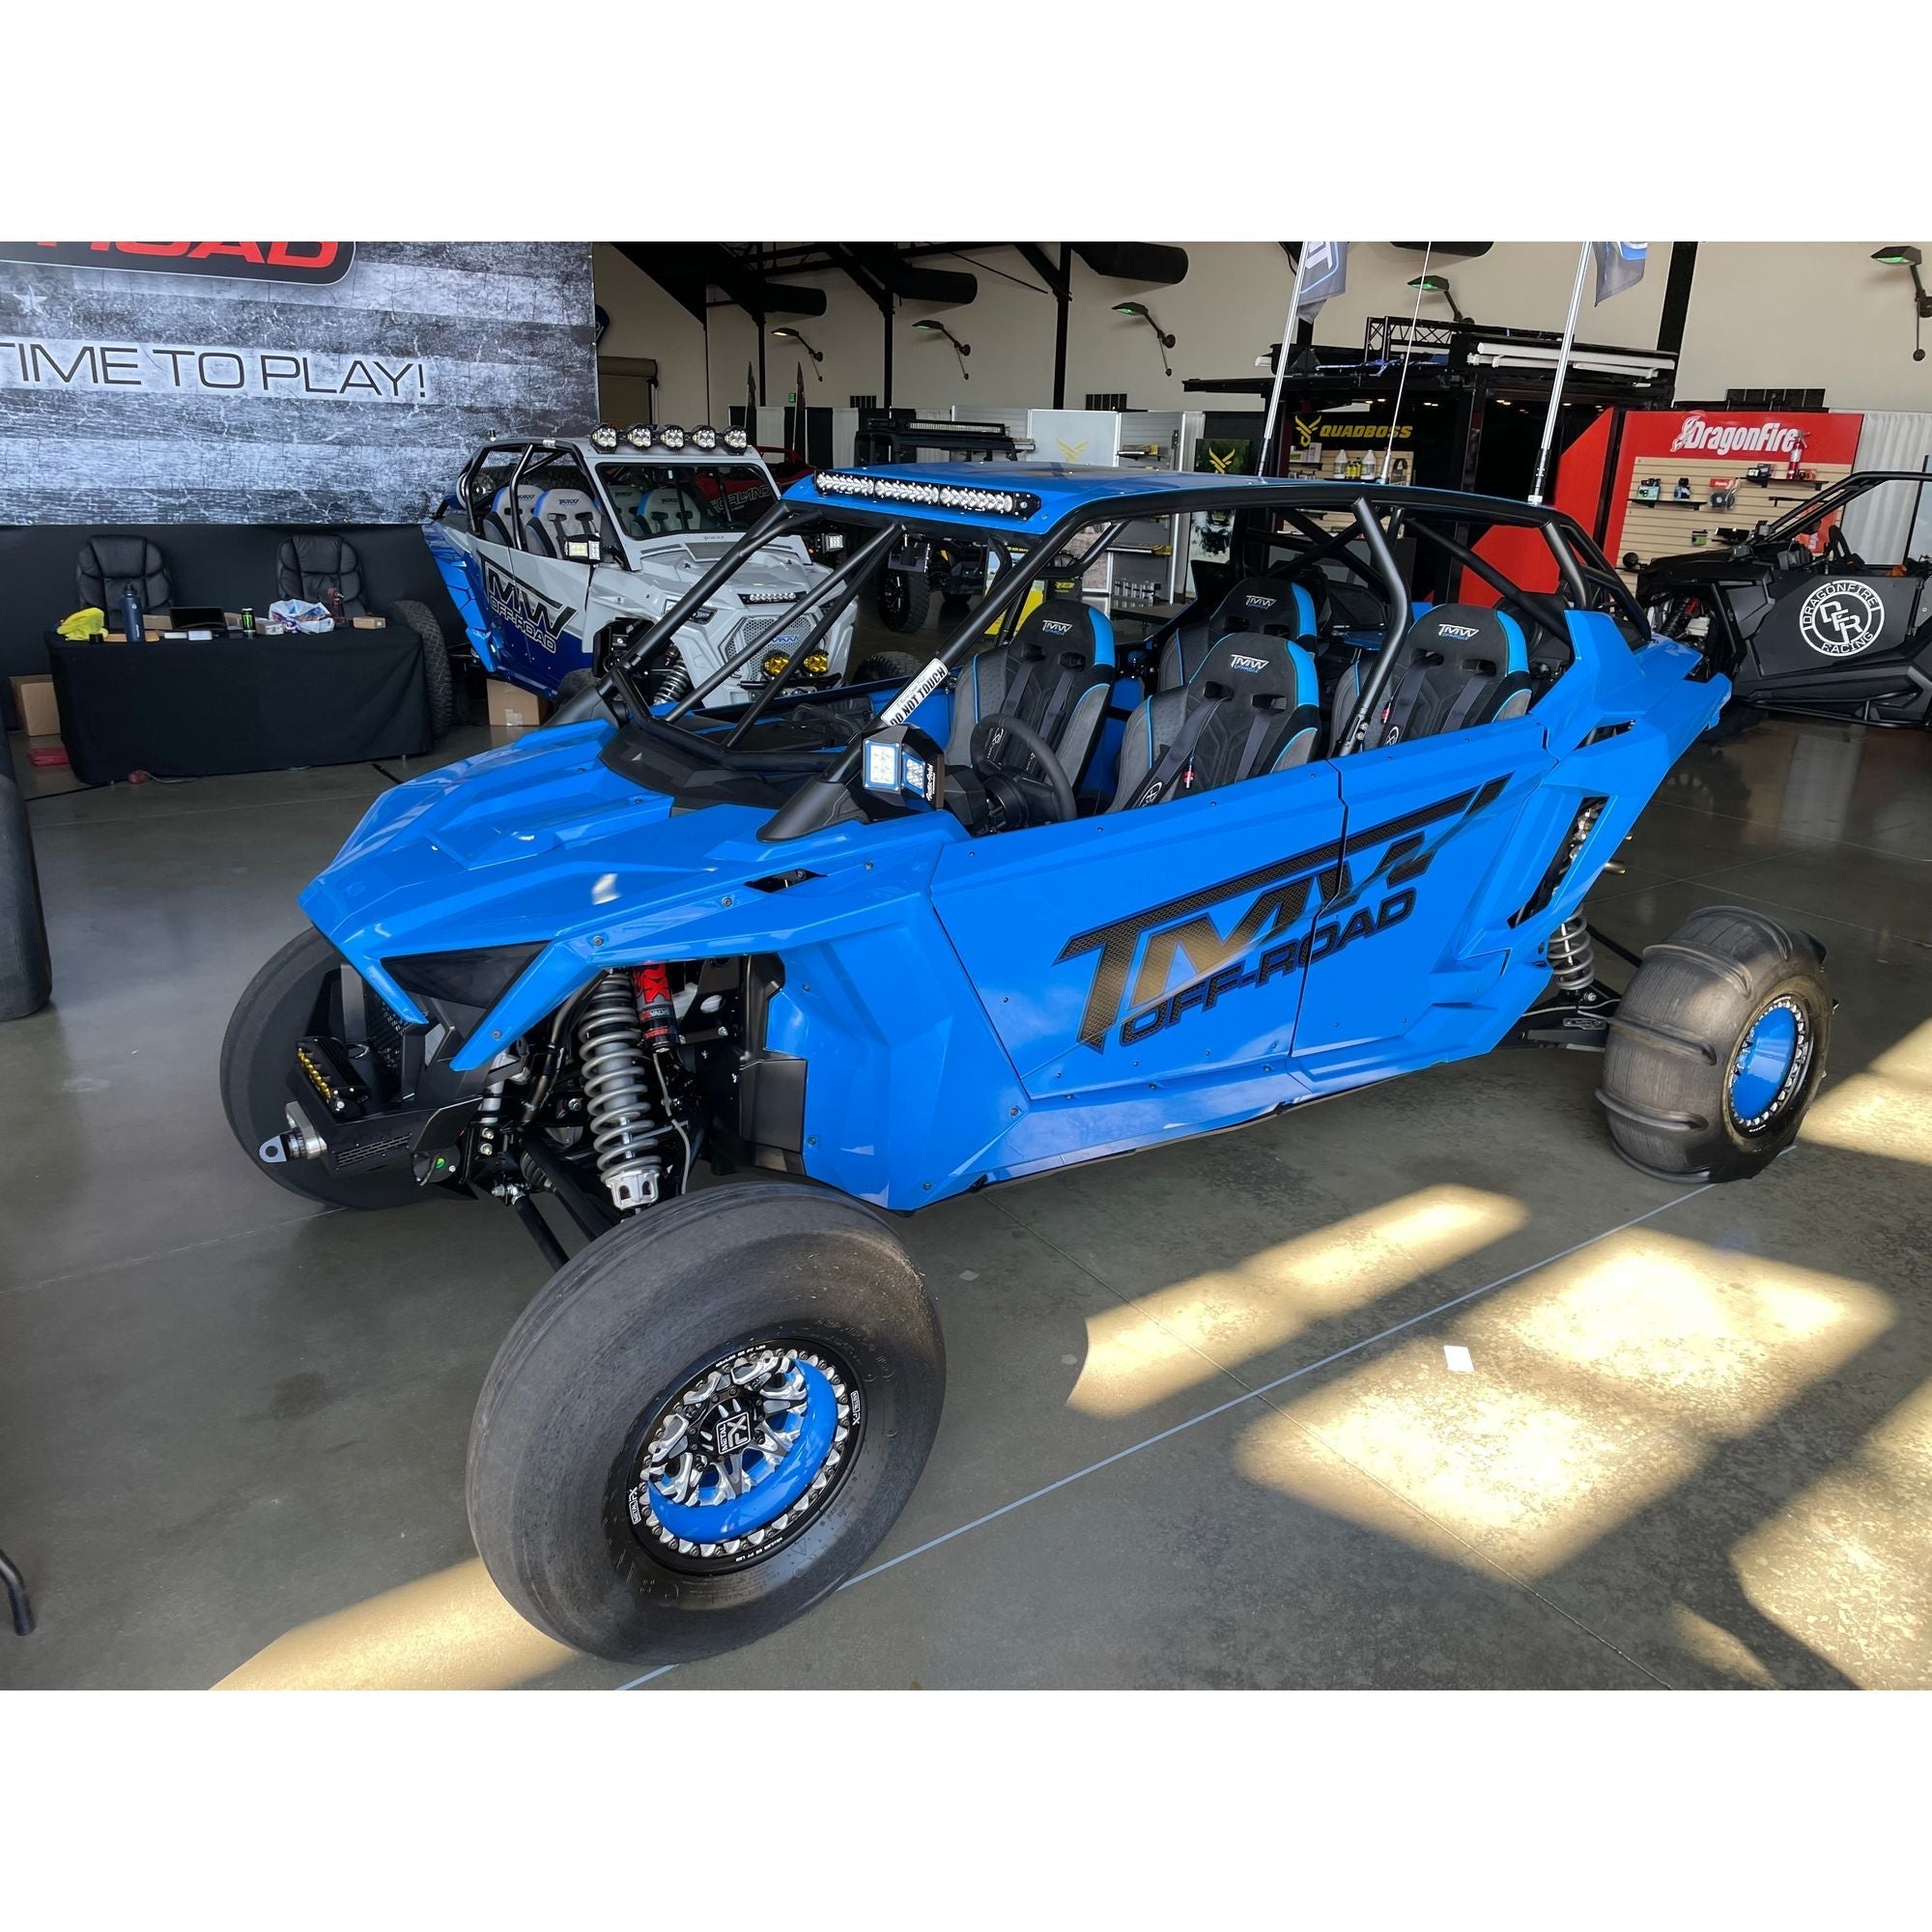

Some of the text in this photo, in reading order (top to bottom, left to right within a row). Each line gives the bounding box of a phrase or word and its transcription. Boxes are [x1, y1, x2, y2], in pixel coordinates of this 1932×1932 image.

[37, 242, 339, 269] AD
[153, 349, 244, 389] TO
[261, 355, 426, 398] PLAY!
[1320, 425, 1412, 439] QUADBOSS
[1683, 420, 1799, 456] DragonFire
[476, 550, 578, 639] TMW
[1803, 582, 1879, 625] DRAGONFIRE
[490, 595, 556, 654] OFF-ROAD
[1042, 619, 1073, 633] TMW
[1437, 623, 1480, 638] TMW
[1821, 631, 1874, 654] RACING
[1230, 654, 1270, 669] TMW
[900, 695, 919, 716] NOT
[917, 667, 946, 699] TOUCH
[1119, 887, 1417, 1047] OFF-ROAD
[720, 1424, 728, 1452] METAL
